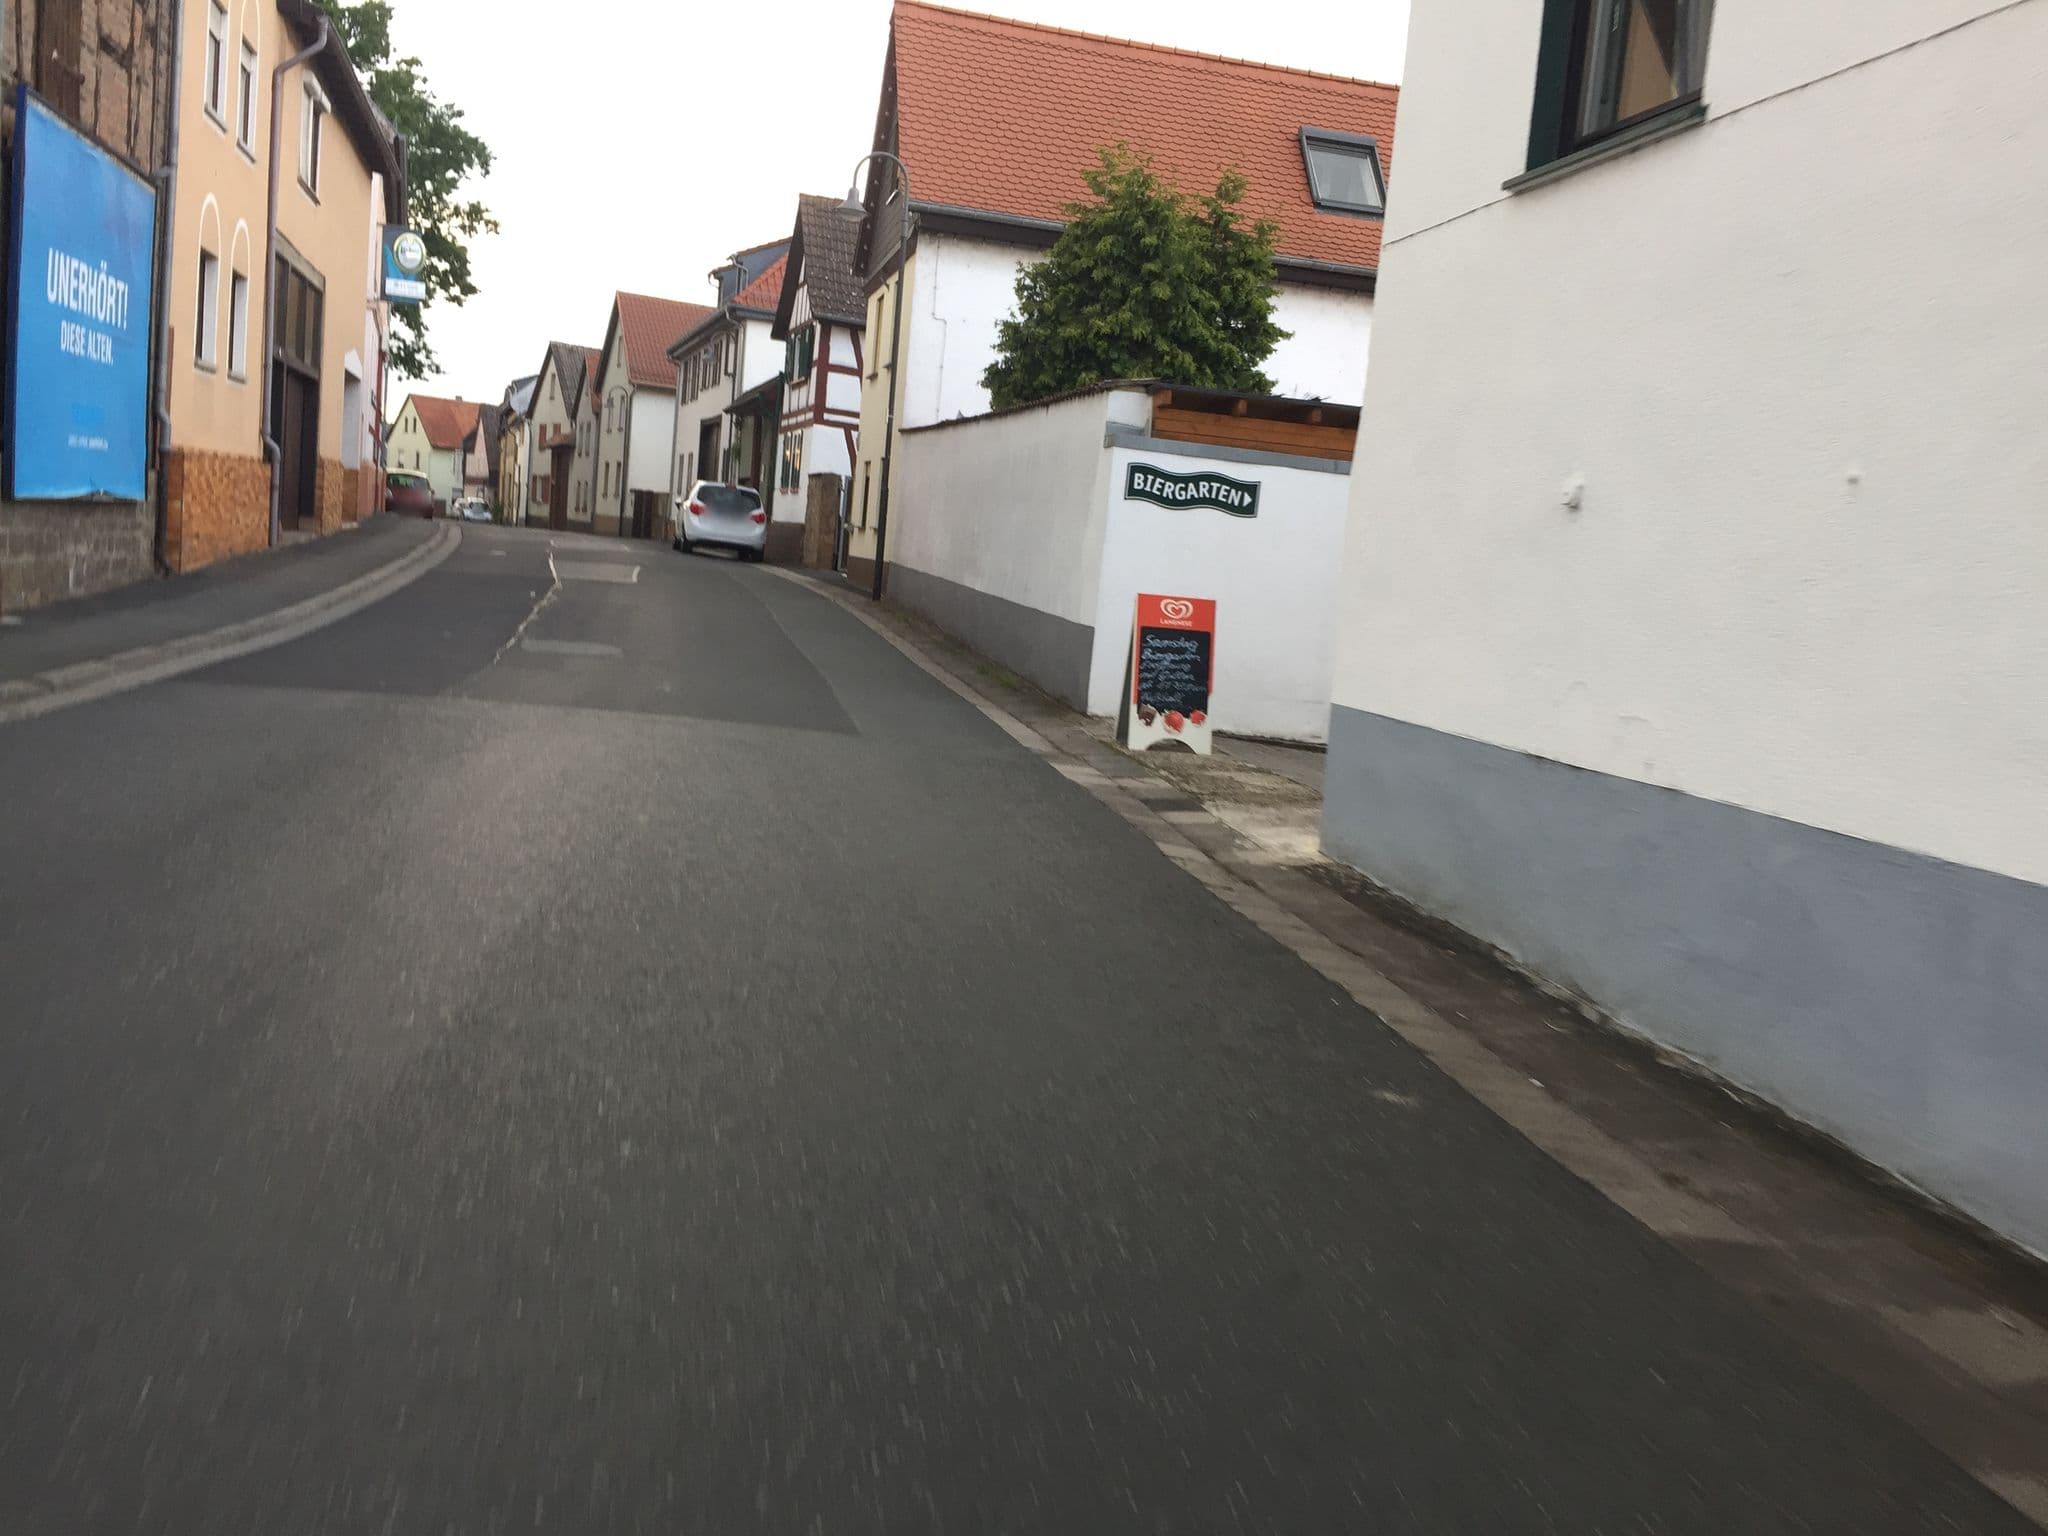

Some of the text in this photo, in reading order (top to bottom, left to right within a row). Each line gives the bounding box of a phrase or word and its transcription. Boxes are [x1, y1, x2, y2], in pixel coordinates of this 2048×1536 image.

[46, 247, 128, 331] UNERHÖRT!
[60, 319, 114, 366] DIESE ALTEN.
[1133, 472, 1242, 507] BIERGARTEN
